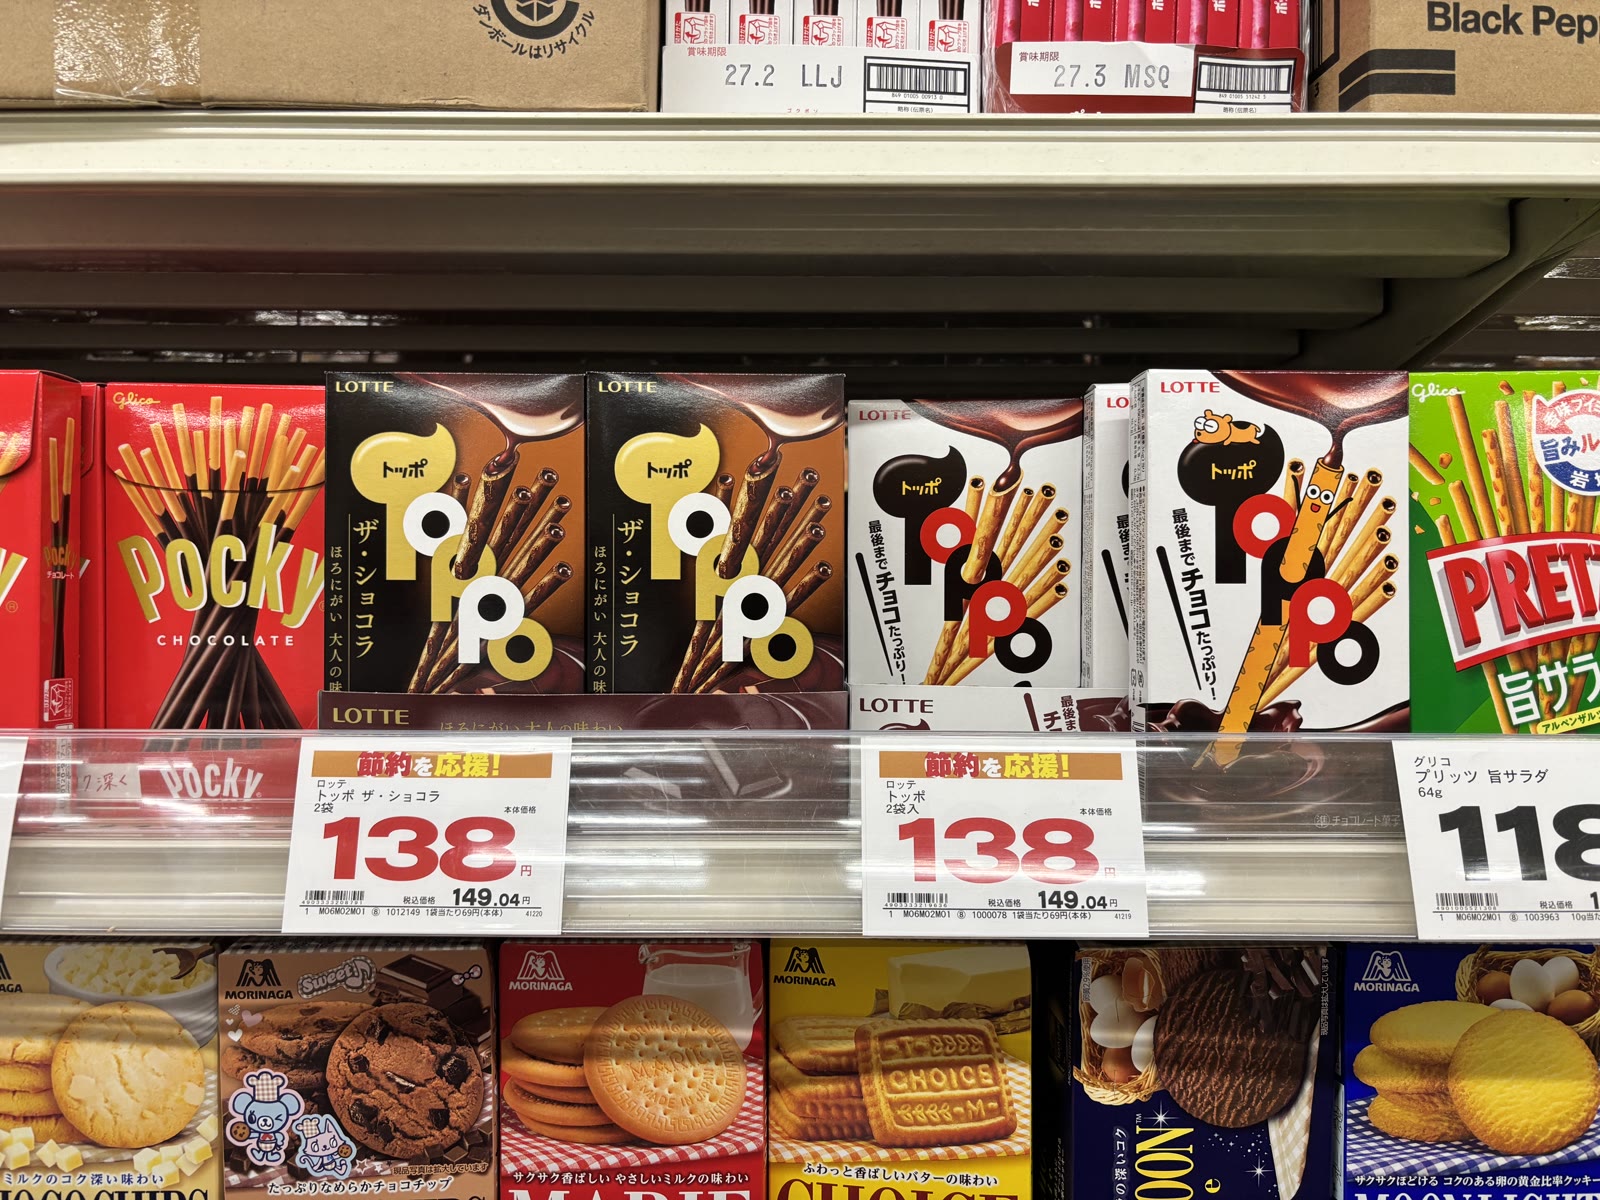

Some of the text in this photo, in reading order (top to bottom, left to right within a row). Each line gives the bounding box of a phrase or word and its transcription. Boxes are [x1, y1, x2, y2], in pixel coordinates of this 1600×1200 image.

[1427, 1, 1524, 35] Black
[473, 4, 595, 59] ダンボールはリサイクル
[687, 46, 727, 57] 賞味期限
[1018, 51, 1060, 62] 賞味期限
[725, 64, 842, 88] 27.2 LLJ
[1053, 64, 1170, 89] 27.3 MSQ
[335, 380, 394, 393] LOTTE
[598, 381, 657, 393] LOTTE
[1160, 381, 1220, 393] LOTTE
[1411, 382, 1465, 403] Glico
[112, 391, 161, 409] Glico
[859, 409, 911, 421] LOTTE
[382, 458, 428, 479] トッポ
[647, 458, 692, 479] トッポ
[1211, 459, 1257, 480] トッポ
[901, 477, 942, 496] トッポ
[329, 546, 343, 622] ほろにがい
[352, 518, 379, 658] ザ・ショコラ
[594, 546, 608, 622] ほろにがい
[617, 518, 643, 657] ザ・ショコラ
[157, 634, 294, 647] CHOCOLATE
[859, 697, 934, 714] LOTTE
[332, 707, 409, 725] LOTTE
[356, 751, 500, 777] 節約を応援!
[924, 751, 1070, 778] 節約を応援!
[1414, 756, 1451, 767] グリコ
[1415, 768, 1549, 783] プリッツ 旨サラダ
[317, 779, 347, 789] ロッテ
[886, 780, 917, 789] ロッテ
[318, 789, 441, 803] トッポ ザ・ショコラ
[888, 790, 926, 803] トッポ
[1418, 787, 1443, 799] 64g
[313, 803, 334, 814] 2袋
[503, 806, 537, 814] 本体価格
[886, 803, 920, 815] 2袋入
[1079, 807, 1112, 816] 本体価格
[323, 816, 532, 883] 138 円
[898, 817, 1099, 885] 138
[402, 888, 531, 907] 税込価格 149.04 円
[988, 890, 1118, 909] 税込価格 149.04 円
[1539, 900, 1573, 910] 税込価格
[304, 907, 309, 915] 1
[387, 908, 421, 916] 1012149
[425, 908, 503, 917] 1袋当たり69円(本体)
[888, 910, 893, 918] 1
[972, 911, 1007, 919] 1000078
[1013, 911, 1092, 920] 1袋当たり69円(本体)
[1439, 913, 1444, 921] 1
[1524, 913, 1560, 921] 1003963
[508, 981, 573, 991] MORINAGA
[773, 975, 836, 987] MORINAGA
[1353, 982, 1420, 993] MORINAGA
[224, 989, 294, 1000] MORINAGA
[889, 1063, 994, 1090] CHOICE
[4, 1173, 164, 1185] ミルクのコク深い味わい
[513, 1171, 749, 1184] サクサク香ばしい やさしいミルクの味わい
[803, 1162, 998, 1187] ふわっと香ばしいバターの味わい
[1355, 1175, 1439, 1187] サクサクほどける
[269, 1176, 453, 1194] たっぷりなめらかチョコチップ
